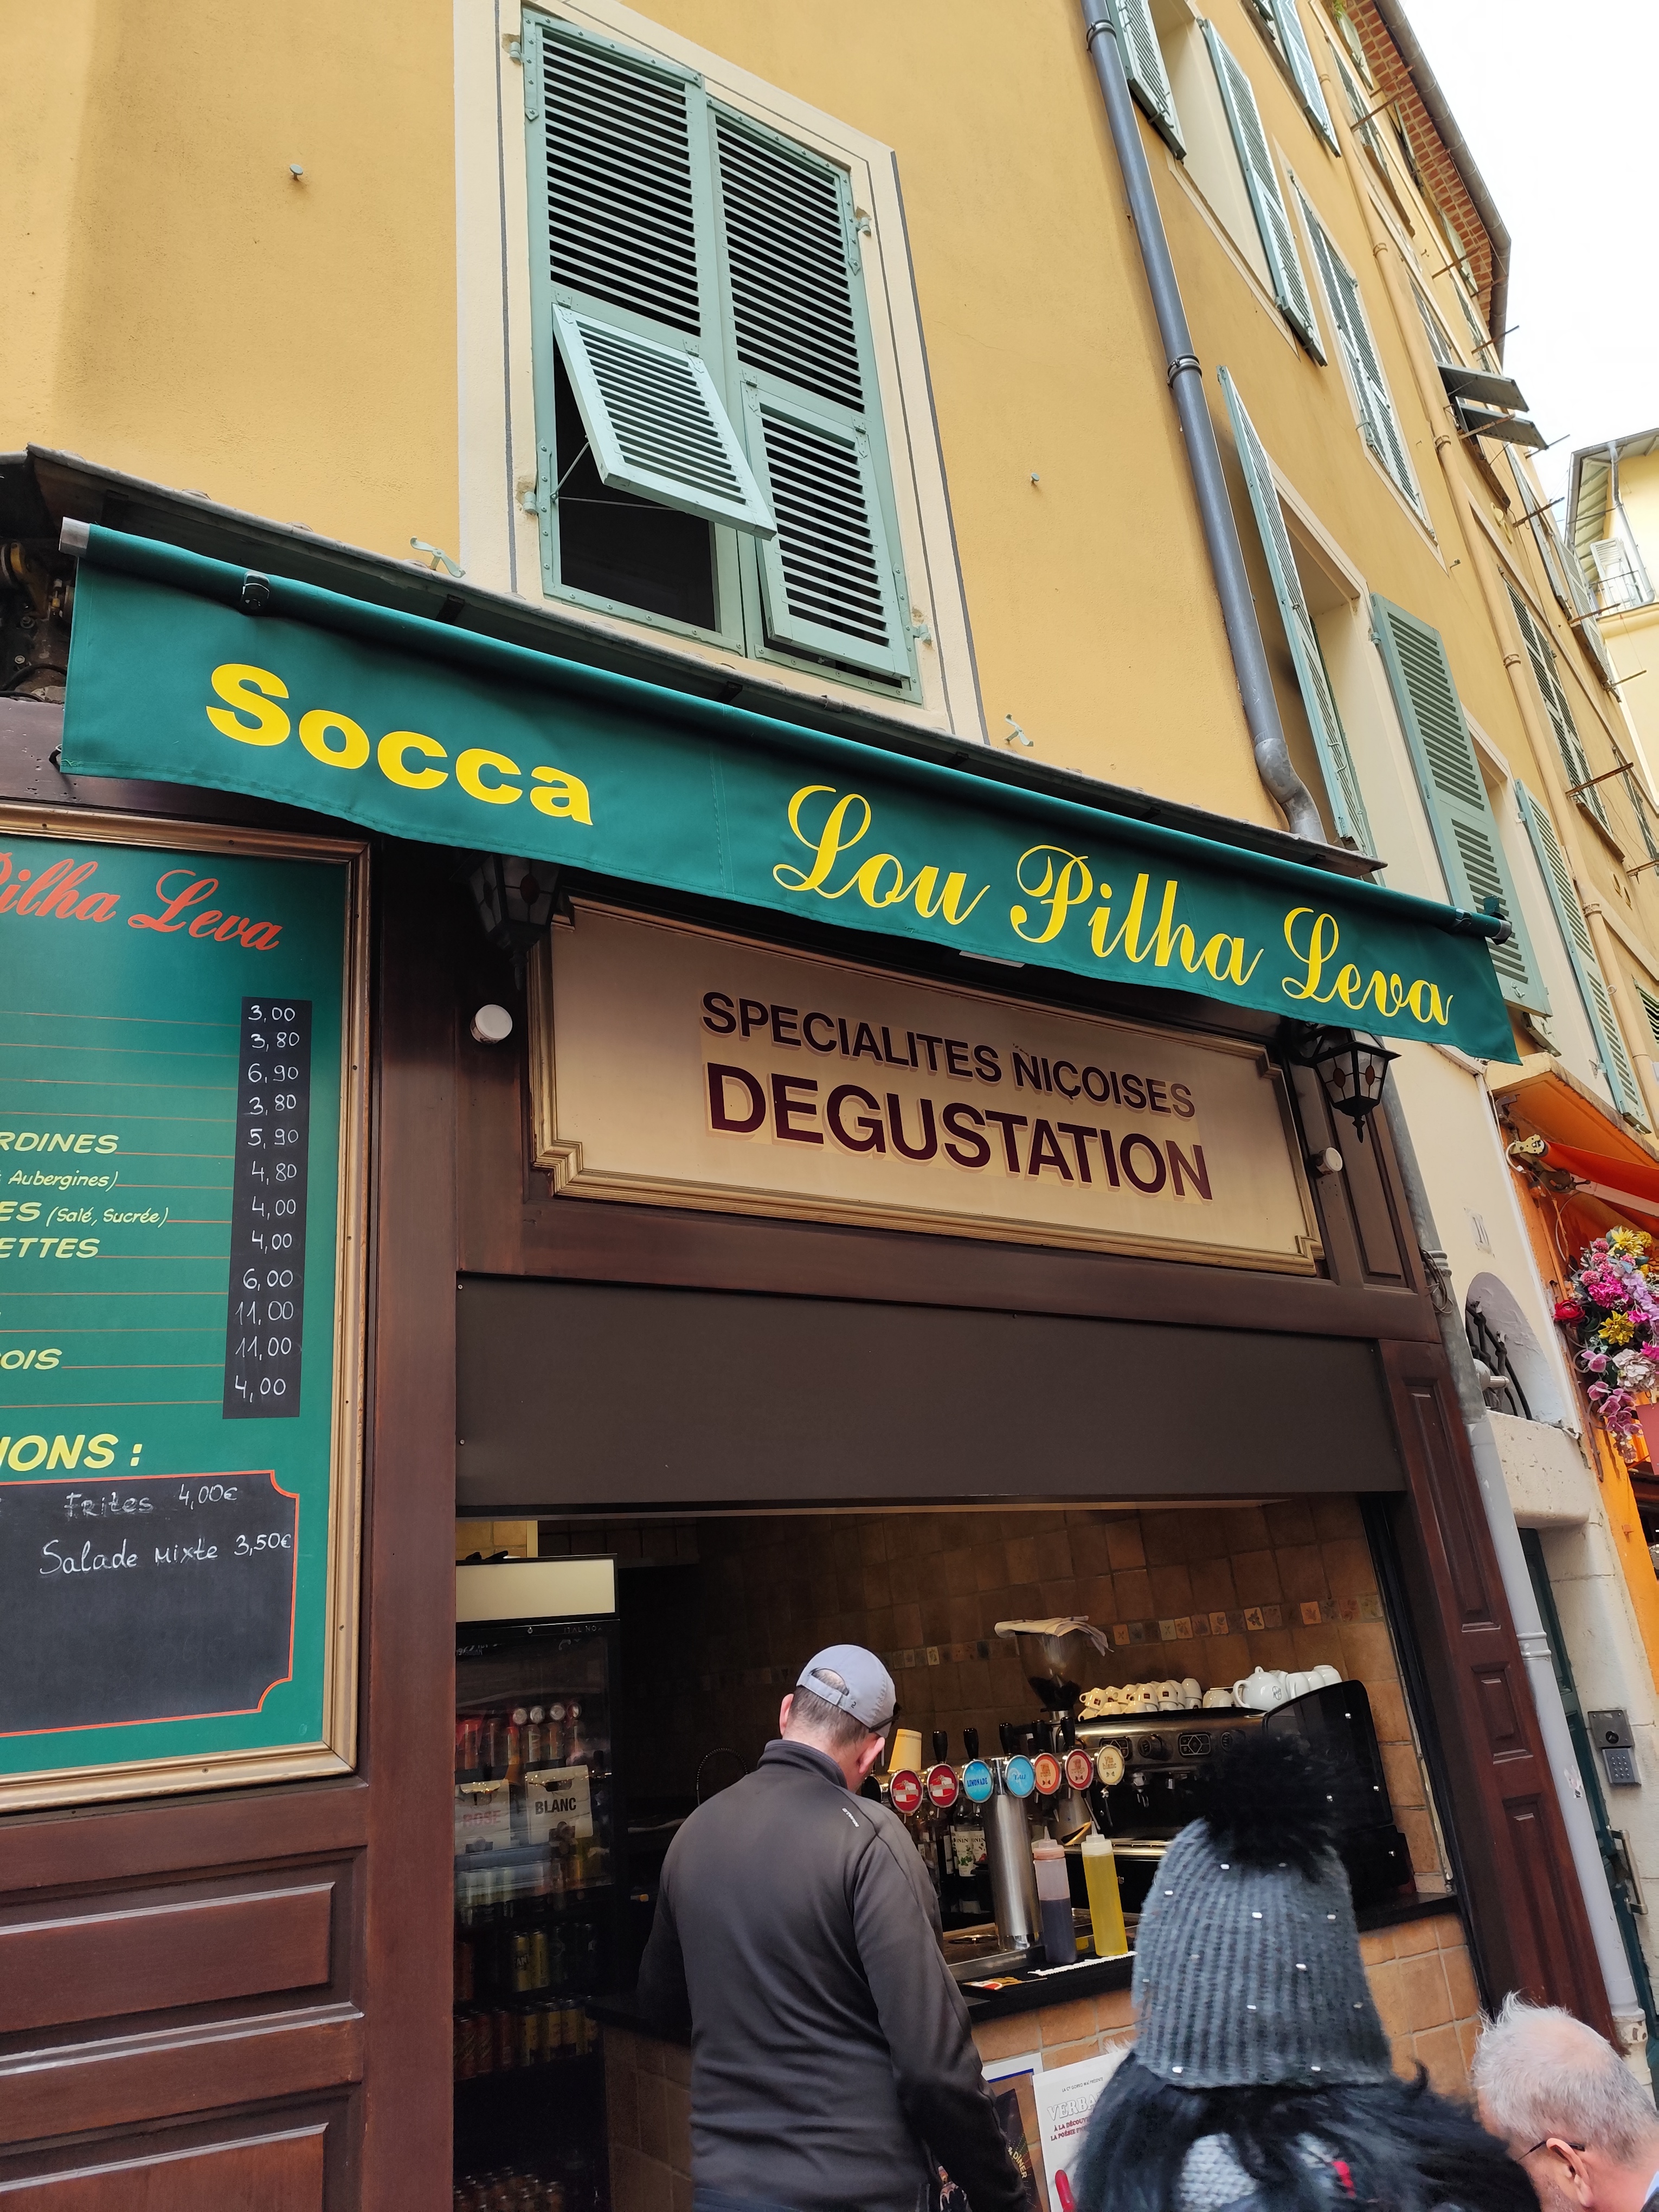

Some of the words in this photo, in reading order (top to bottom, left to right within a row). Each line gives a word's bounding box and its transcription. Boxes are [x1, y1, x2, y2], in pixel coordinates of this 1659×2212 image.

[205, 663, 594, 826] Socca
[127, 869, 284, 951] Leva
[773, 785, 991, 925] Lou
[1009, 844, 1264, 986] Pilha
[1282, 906, 1454, 1026] Leva
[247, 1005, 296, 1024] 3,00
[250, 1031, 300, 1052] 3,80
[702, 991, 1002, 1083] SPECIALITES
[1012, 1051, 1197, 1119] NIÇOISES
[247, 1063, 299, 1084] 6,90
[248, 1093, 297, 1116] 3,80
[247, 1128, 299, 1150] 5,90
[705, 1061, 1213, 1200] DEGUSTATION
[7, 1169, 119, 1193] Aubergines)
[250, 1161, 298, 1185] 4,80
[0, 1200, 42, 1222] ES
[46, 1205, 98, 1227] (Salé,
[102, 1206, 169, 1229] Sucrée)
[250, 1195, 297, 1220] 4,00
[0, 1237, 101, 1259] ETTES
[250, 1230, 293, 1254] 4,00
[242, 1268, 294, 1291] 6,00
[234, 1300, 294, 1326] 11,00
[0, 1348, 63, 1370] OIS
[235, 1336, 292, 1361] 11,00
[234, 1375, 287, 1403] 4,00
[177, 1483, 239, 1511] 4,00€
[39, 1538, 138, 1576] Salade
[233, 1532, 292, 1557] 3,50€
[967, 1777, 989, 1788] LIMONADE
[535, 1797, 577, 1815] BLANC
[1047, 2092, 1101, 2121] VERBA
